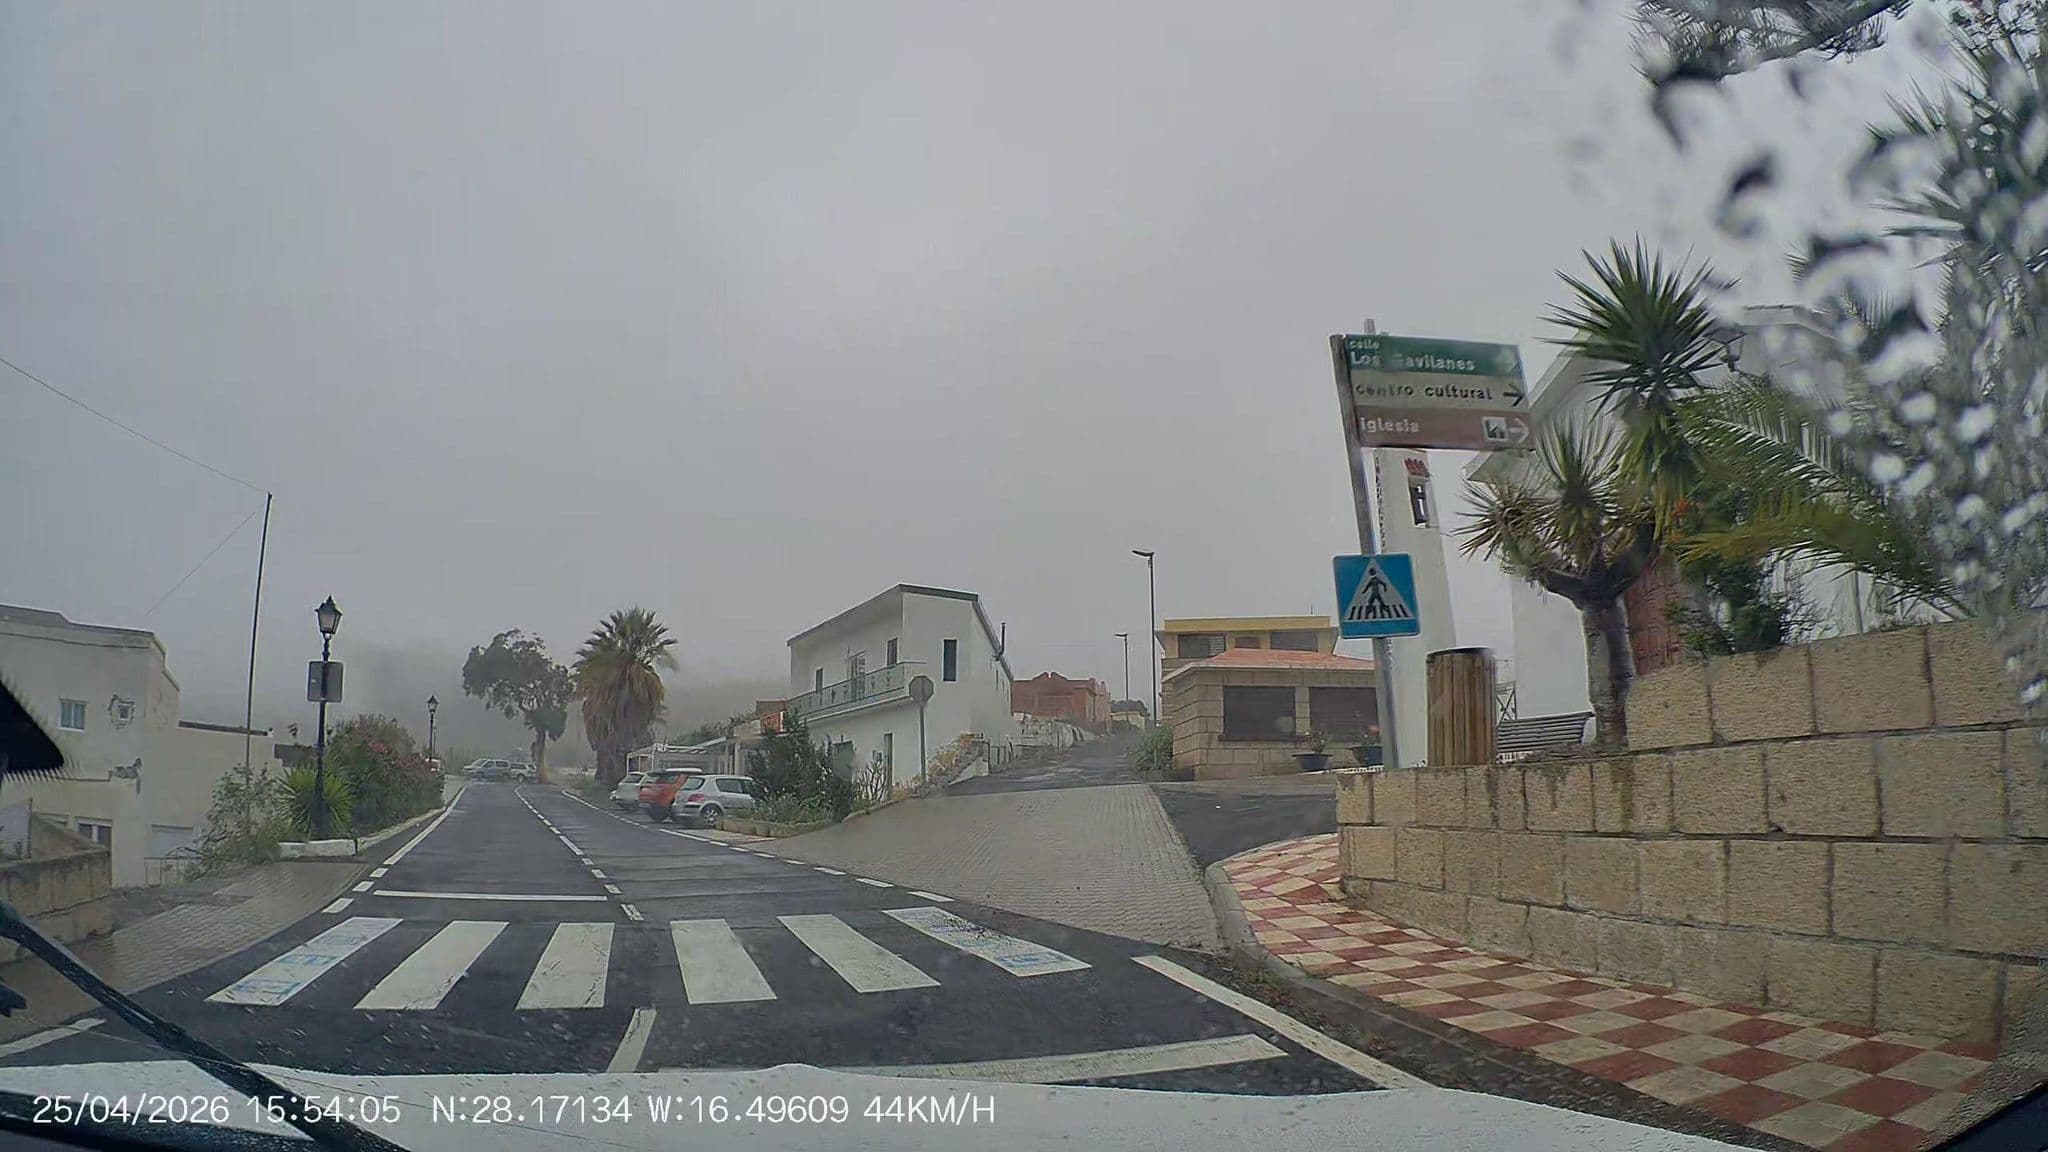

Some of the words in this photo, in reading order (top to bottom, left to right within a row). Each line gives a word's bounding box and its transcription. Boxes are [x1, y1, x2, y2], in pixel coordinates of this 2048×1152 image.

[1350, 351, 1380, 368] Los
[1392, 353, 1475, 371] avilanes
[1424, 384, 1493, 400] cultural
